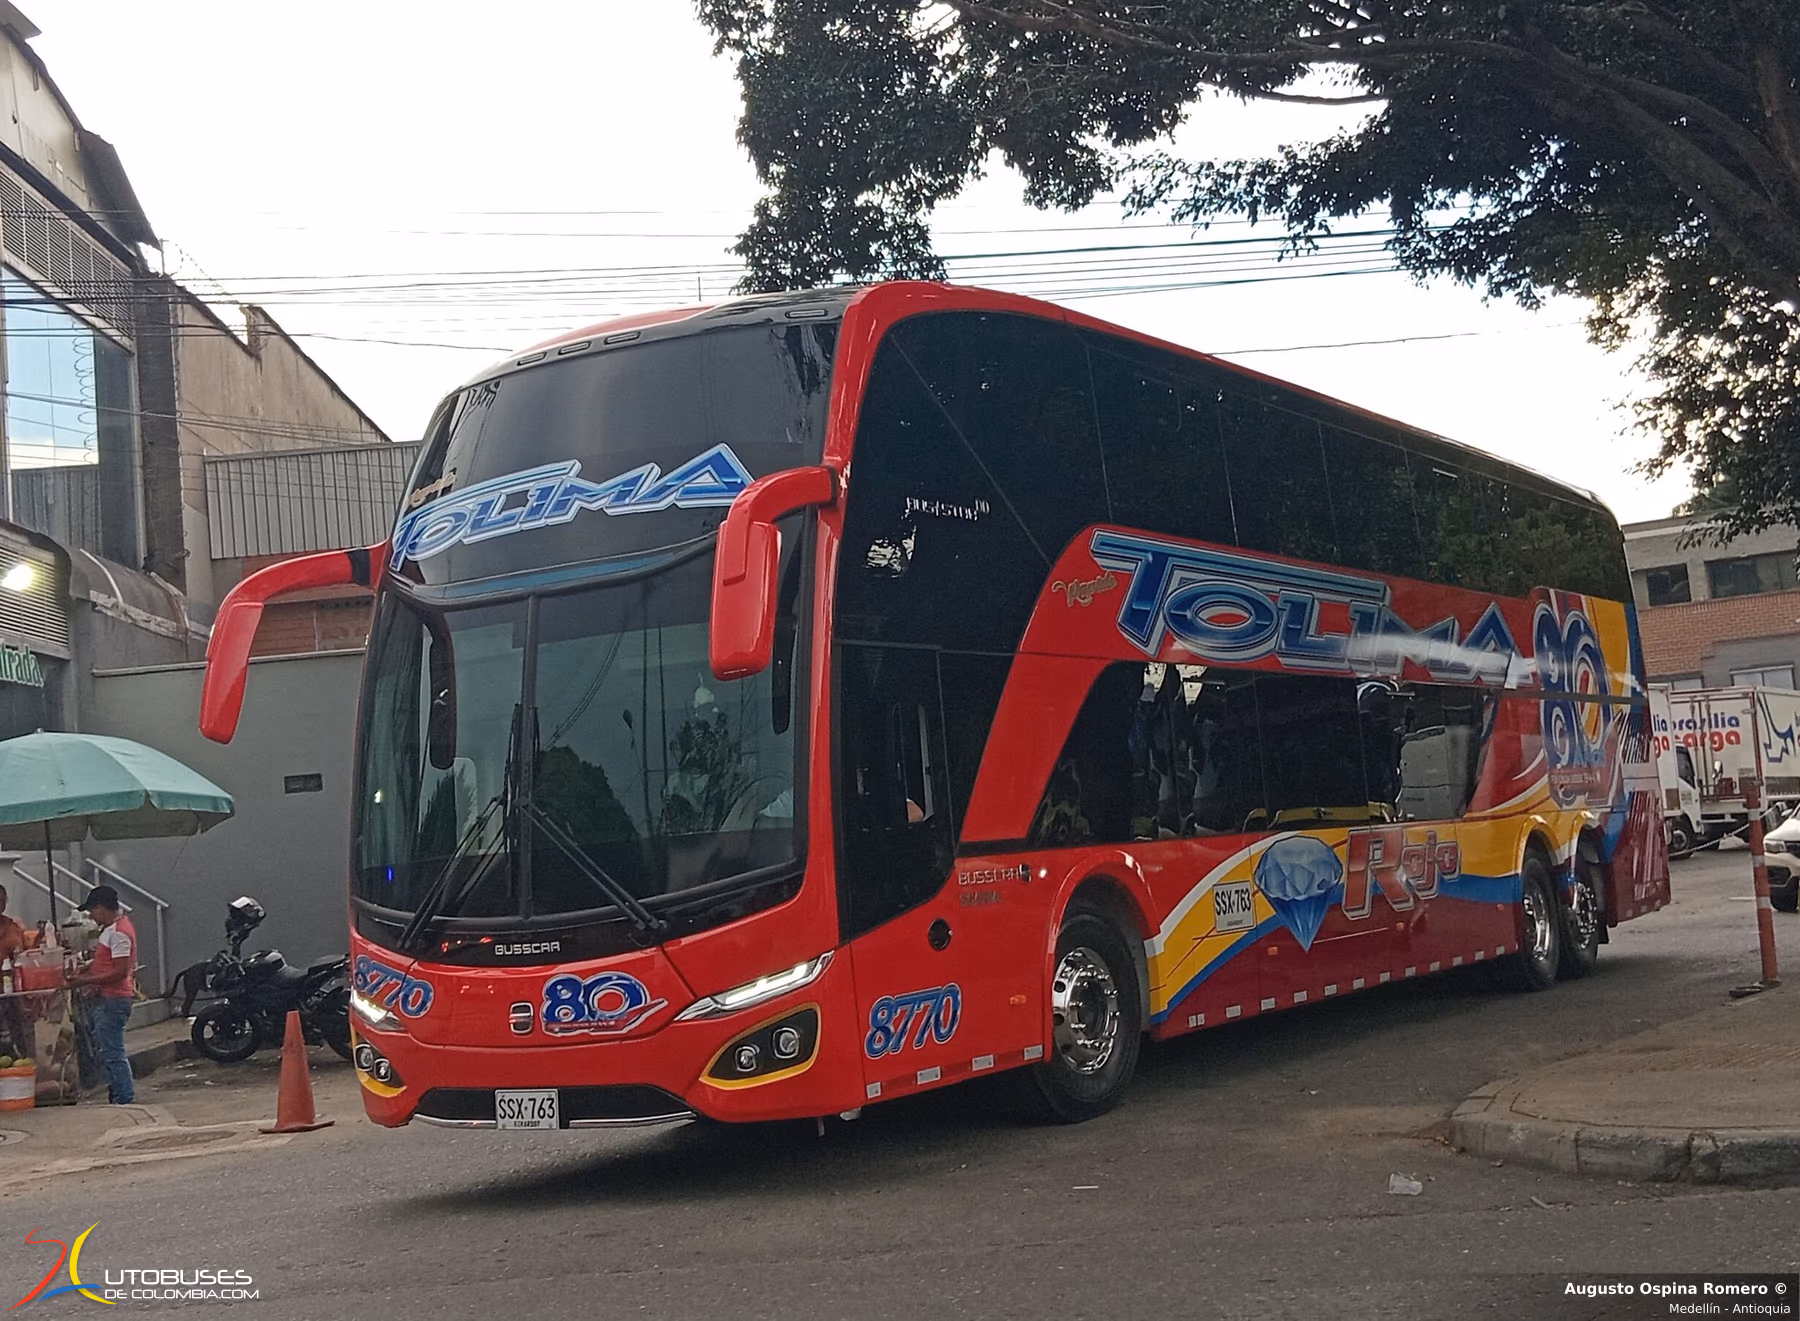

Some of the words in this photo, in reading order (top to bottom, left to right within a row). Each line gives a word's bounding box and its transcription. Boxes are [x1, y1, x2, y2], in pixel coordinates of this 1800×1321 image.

[390, 442, 754, 571] TOLIMA
[1089, 528, 1535, 690] TOLIMA
[0, 641, 44, 687] trada
[494, 940, 561, 956] BUSSCAR
[353, 954, 435, 1019] 8770
[540, 971, 651, 1023] 80
[865, 982, 962, 1060] 8770
